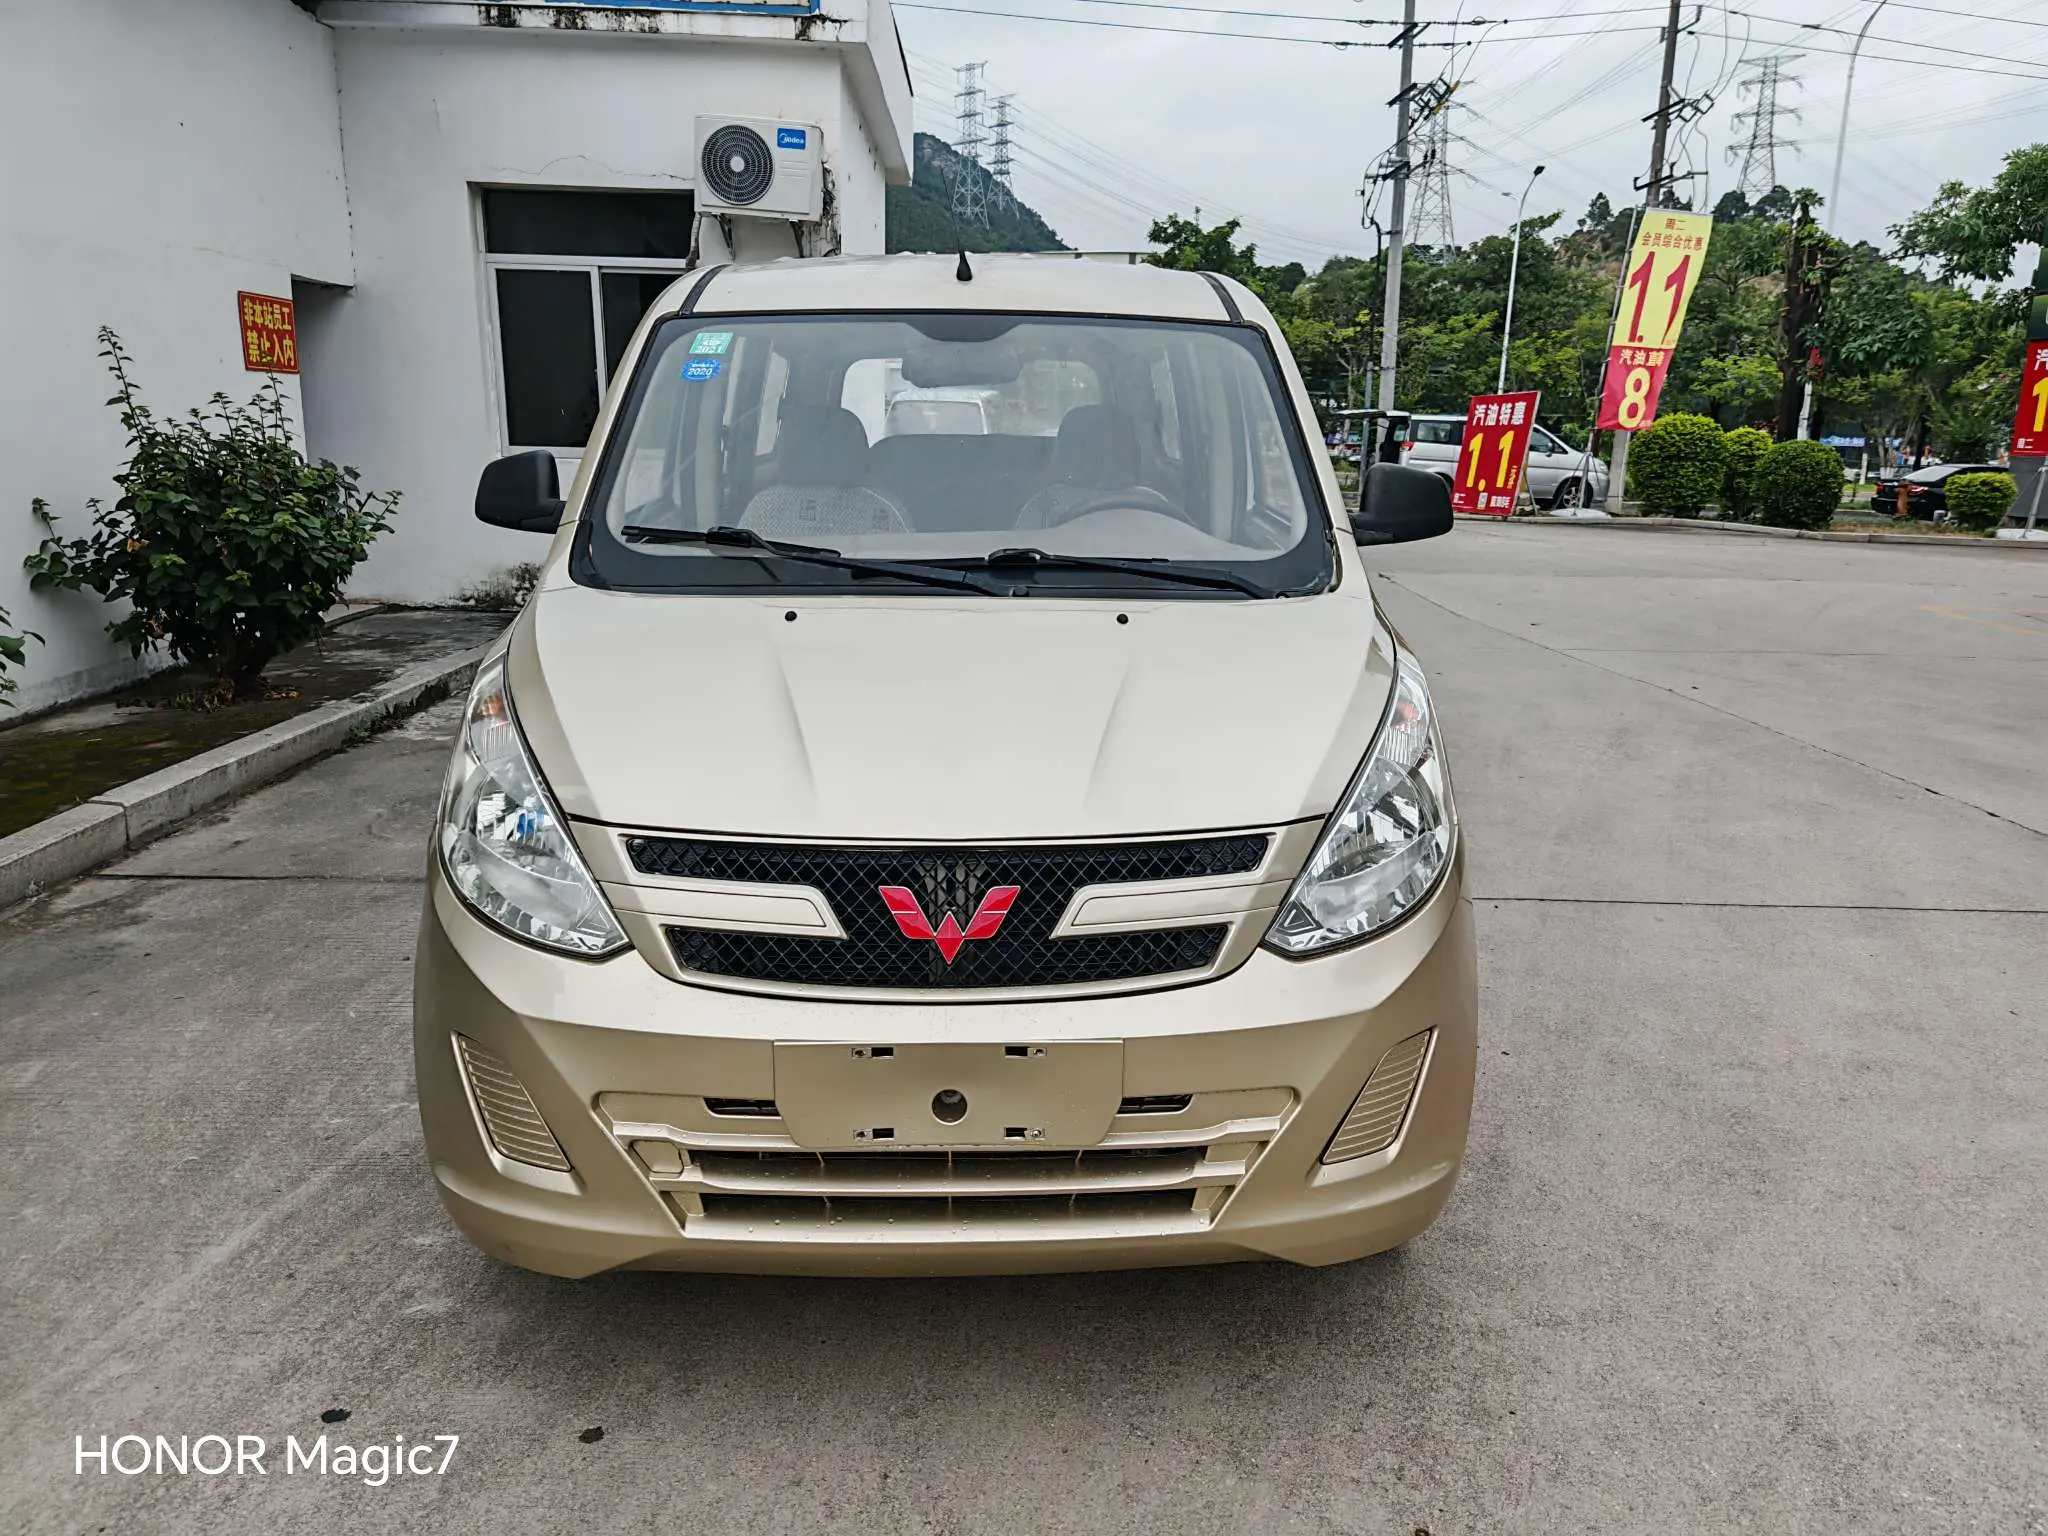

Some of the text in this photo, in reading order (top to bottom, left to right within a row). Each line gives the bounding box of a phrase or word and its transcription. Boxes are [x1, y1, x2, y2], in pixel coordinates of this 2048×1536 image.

[1642, 232, 1704, 250] 会员综合优惠
[244, 298, 291, 330] 非本站员工
[247, 329, 294, 366] 禁止入内
[687, 367, 713, 376] 2020
[1618, 367, 1651, 428] 8
[1473, 401, 1527, 426] 汽油特惠
